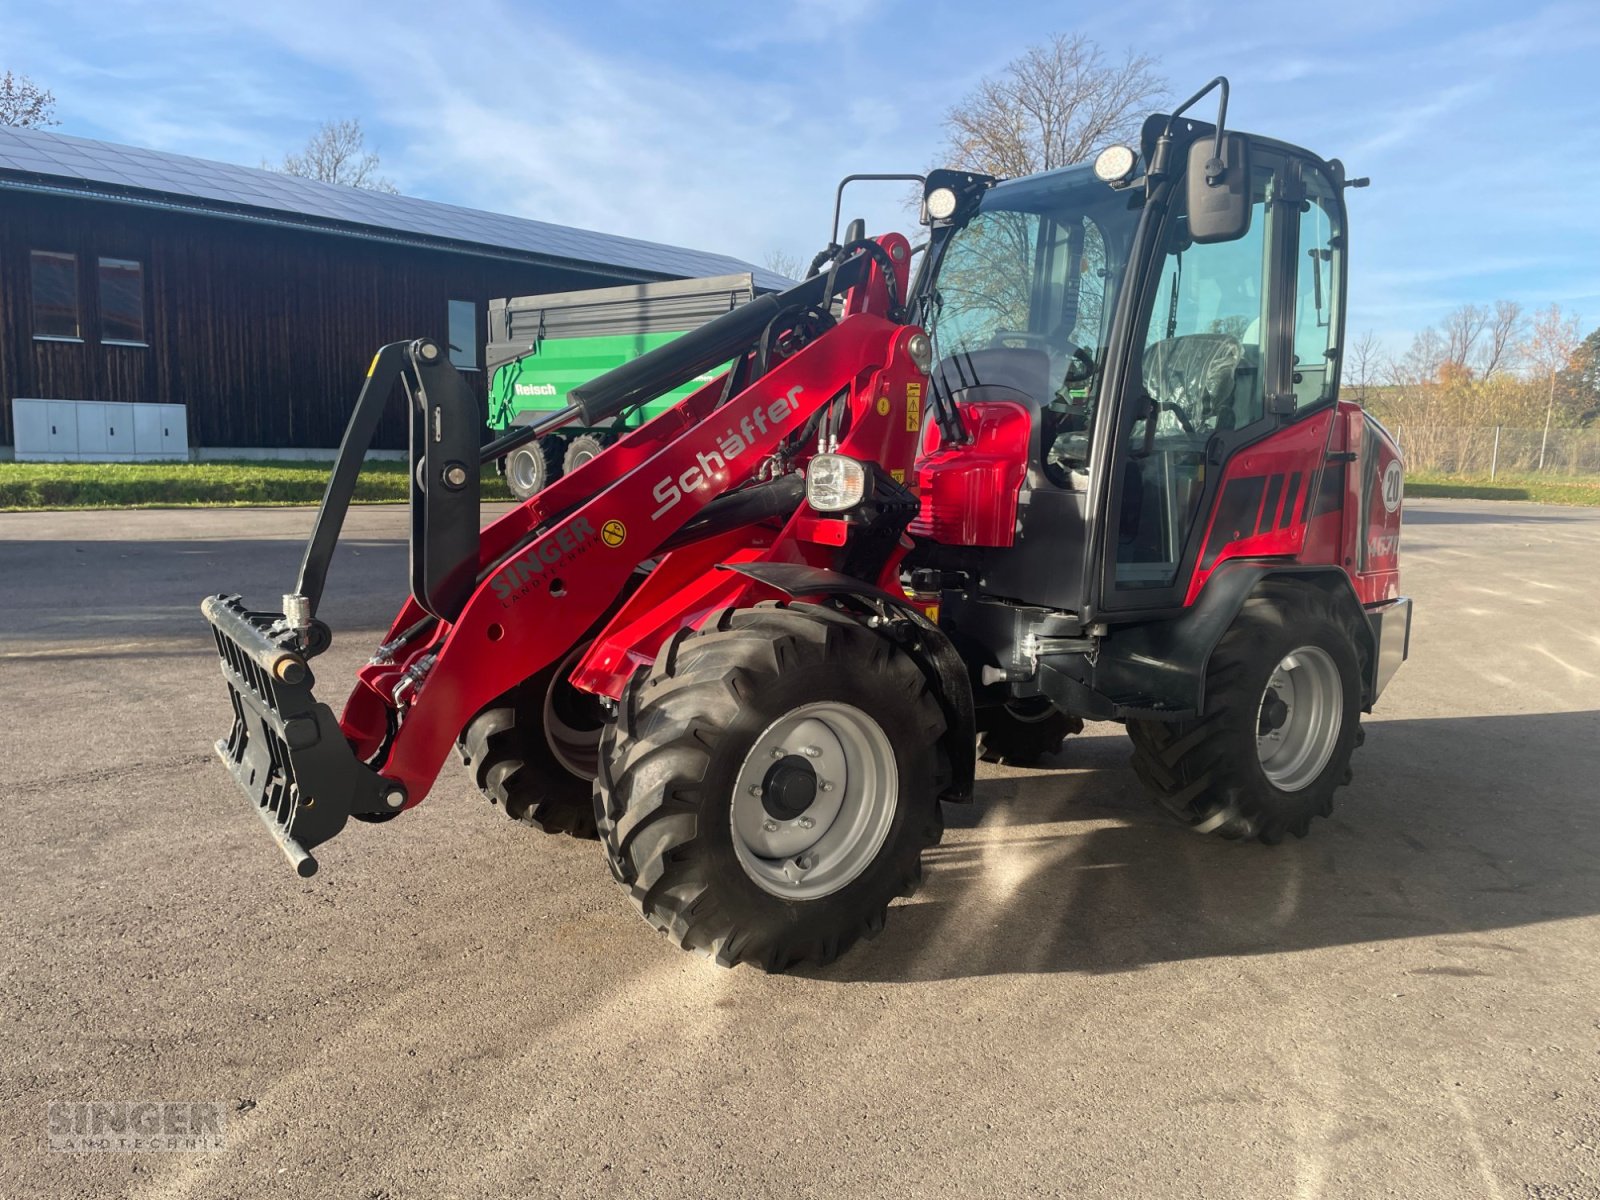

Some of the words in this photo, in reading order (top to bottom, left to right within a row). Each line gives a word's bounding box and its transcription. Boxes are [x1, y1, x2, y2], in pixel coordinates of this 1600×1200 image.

[514, 383, 557, 396] Reisch
[651, 385, 804, 521] Schäffer
[1387, 470, 1399, 503] 20
[490, 516, 595, 600] SINGER
